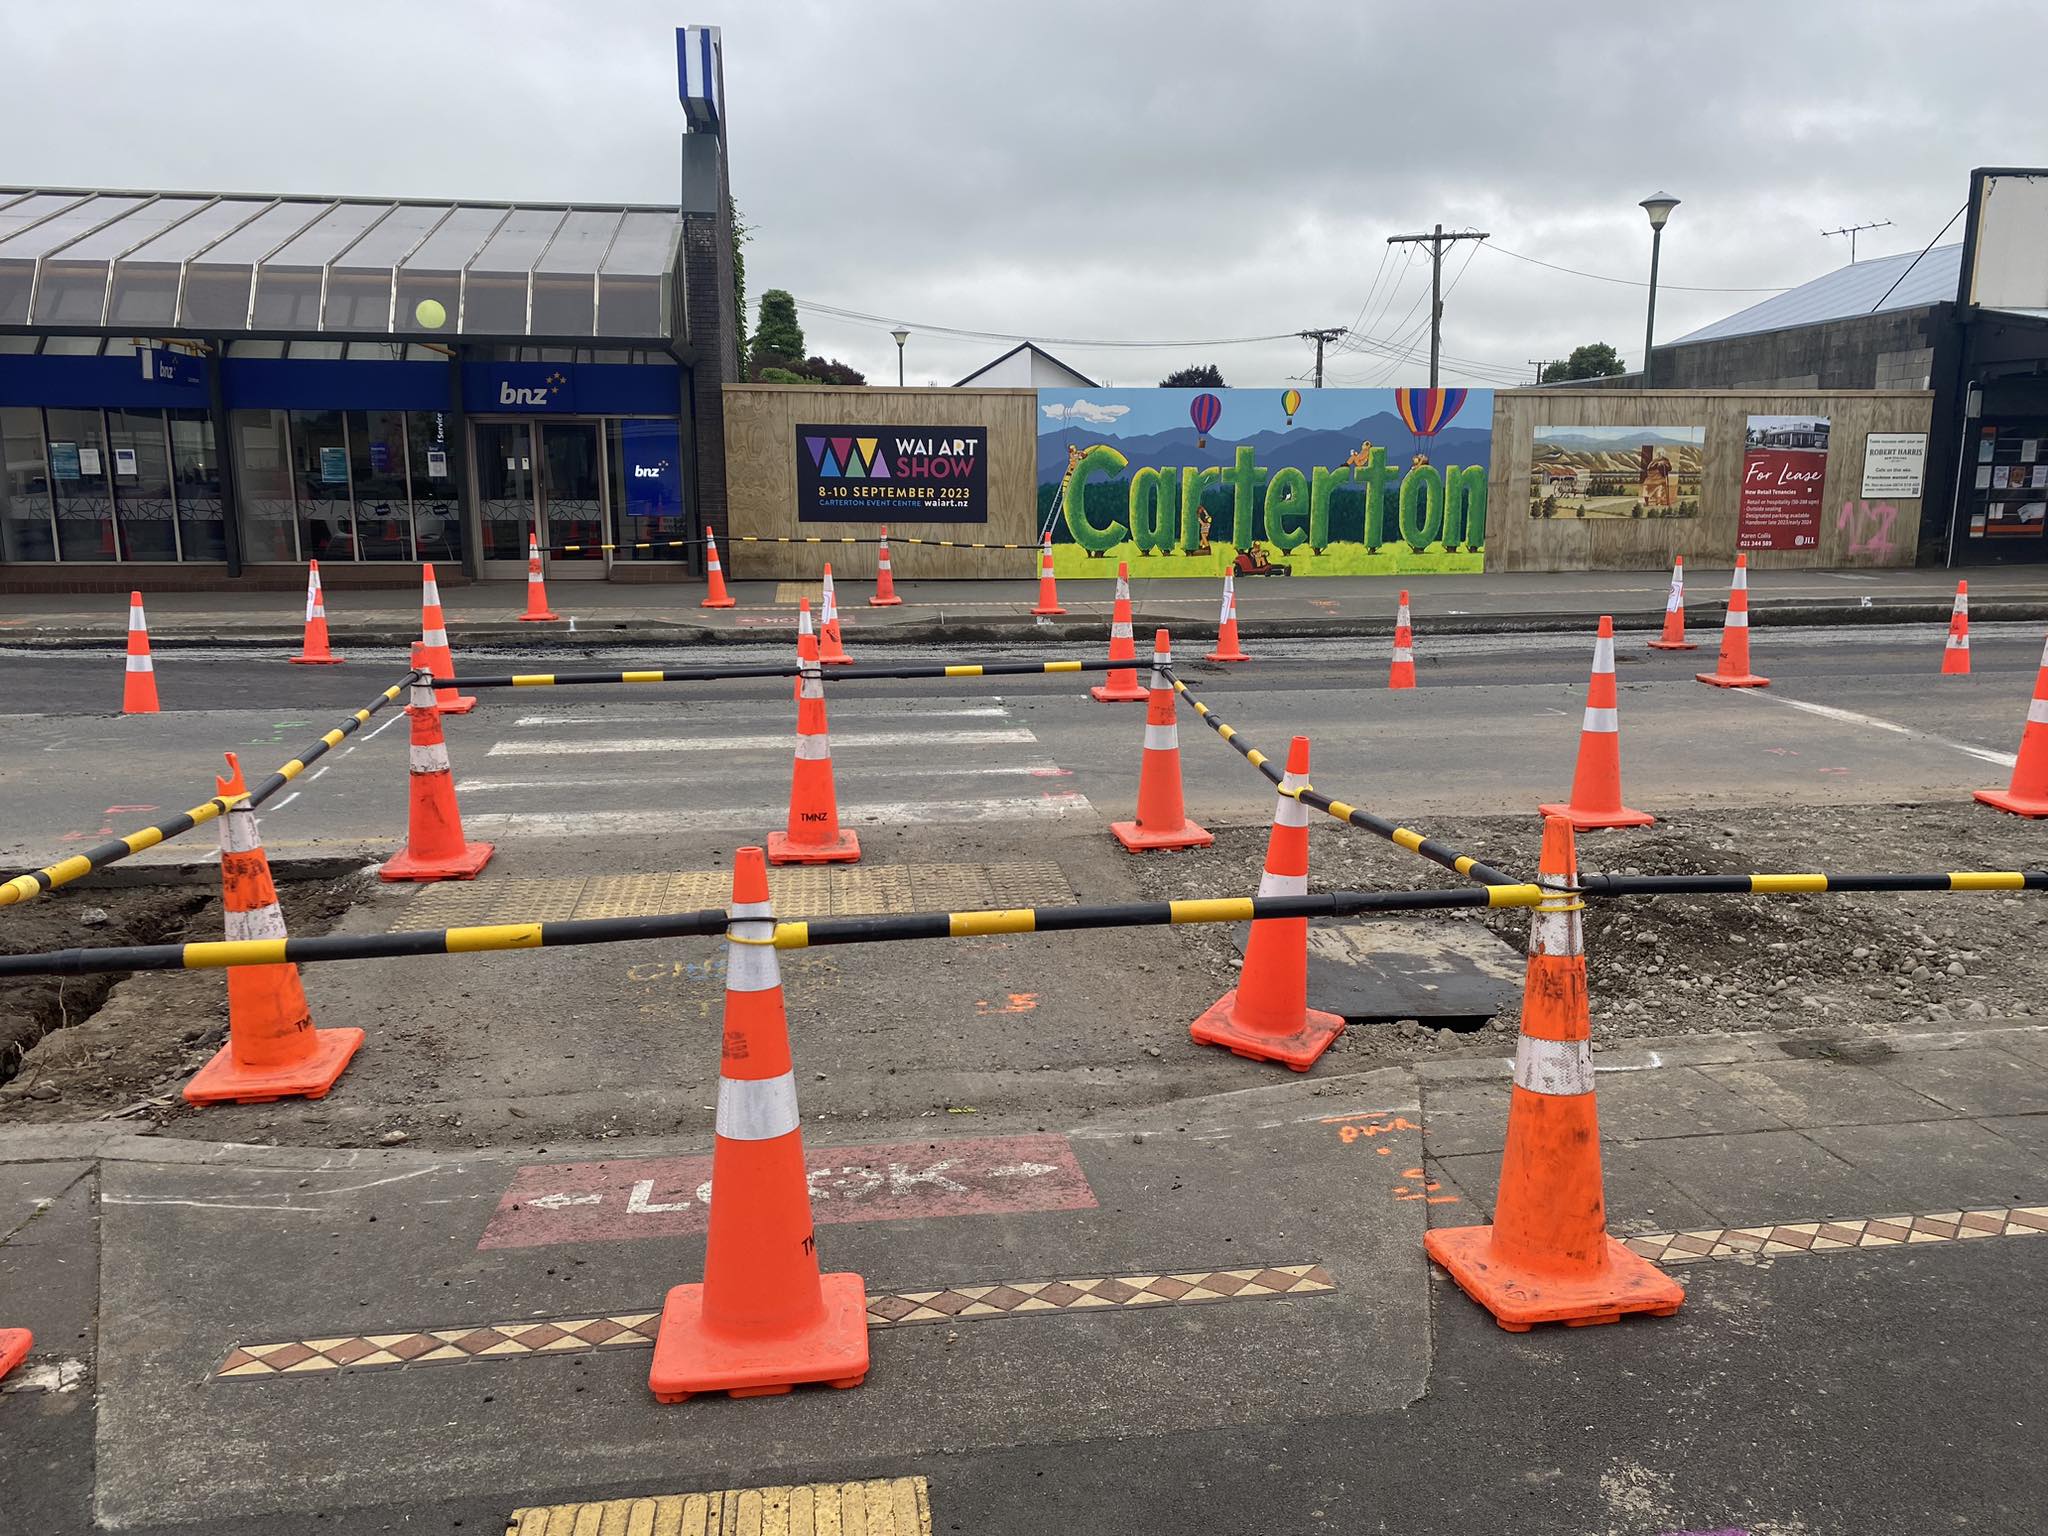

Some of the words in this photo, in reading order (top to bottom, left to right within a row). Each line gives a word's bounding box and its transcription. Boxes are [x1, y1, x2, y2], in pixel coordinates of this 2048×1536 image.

[160, 360, 174, 379] bnz
[499, 381, 548, 405] bnz
[895, 438, 933, 456] WAI
[938, 439, 978, 456] ART
[1869, 448, 1897, 456] ROBERT
[1897, 448, 1923, 456] HARRIS
[634, 464, 660, 478] bnz
[896, 456, 976, 479] SHOW
[1745, 462, 1773, 484] For
[1778, 462, 1823, 486] Lease
[818, 486, 848, 497] 8-10
[853, 486, 935, 498] SEPTEMBER
[940, 487, 970, 498] 2023
[1063, 444, 1488, 554] Carterton
[924, 499, 969, 507] waiart.nz
[1803, 536, 1815, 544] JLL
[800, 812, 827, 822] TMNZ
